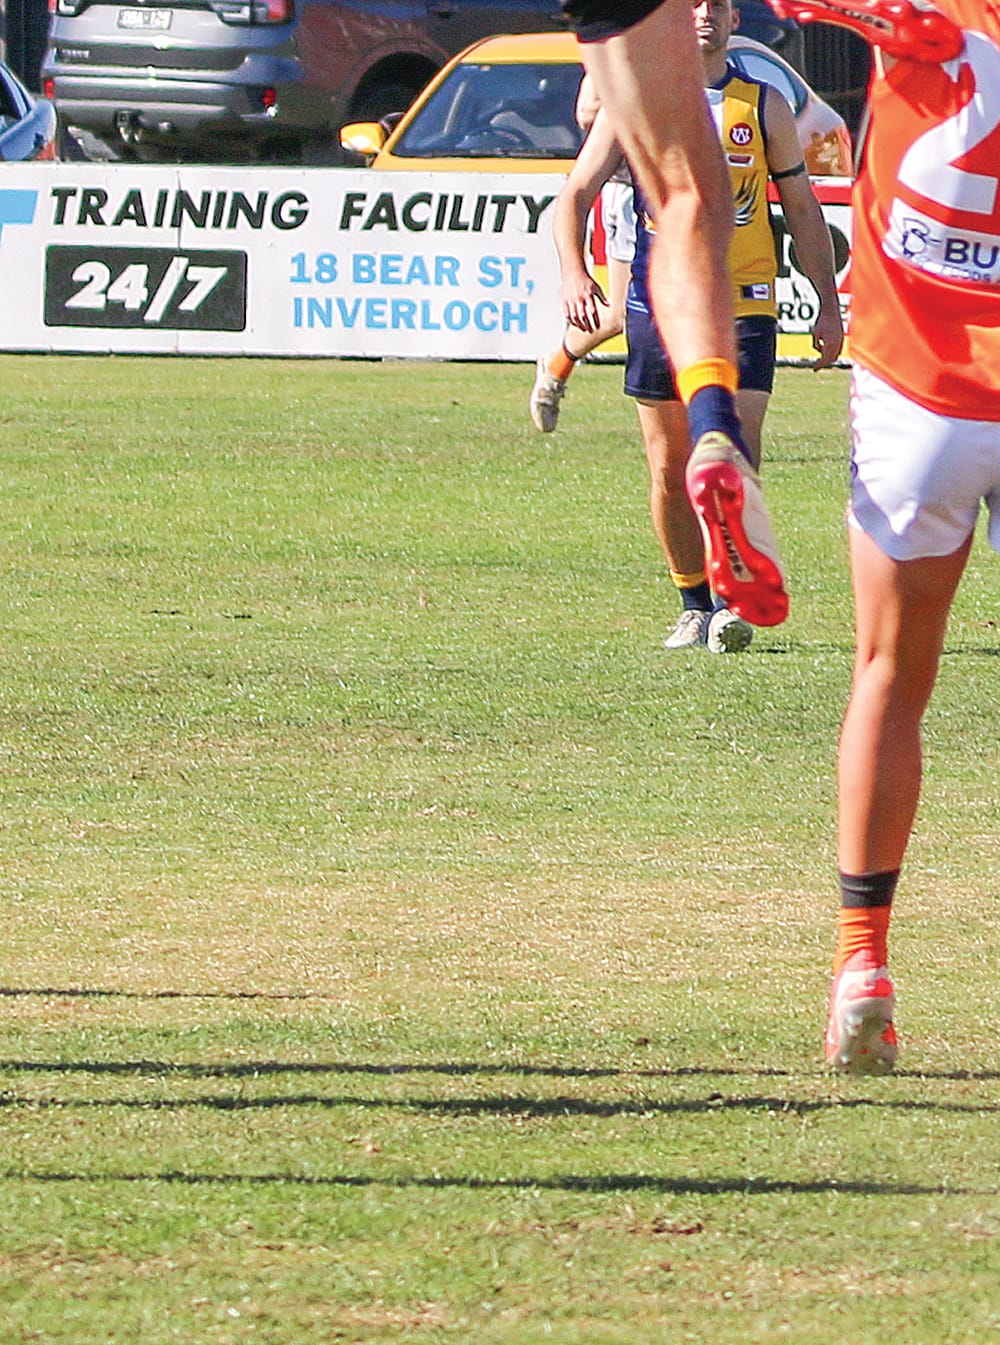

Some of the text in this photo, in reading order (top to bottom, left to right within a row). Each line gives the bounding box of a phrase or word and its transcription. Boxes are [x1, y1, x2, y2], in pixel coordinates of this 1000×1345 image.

[50, 186, 309, 231] TRAINING
[340, 192, 557, 234] FACILITY
[65, 257, 228, 323] 24/7
[289, 253, 535, 295] 18 BEAR ST,
[293, 297, 529, 334] INVERLOCH
